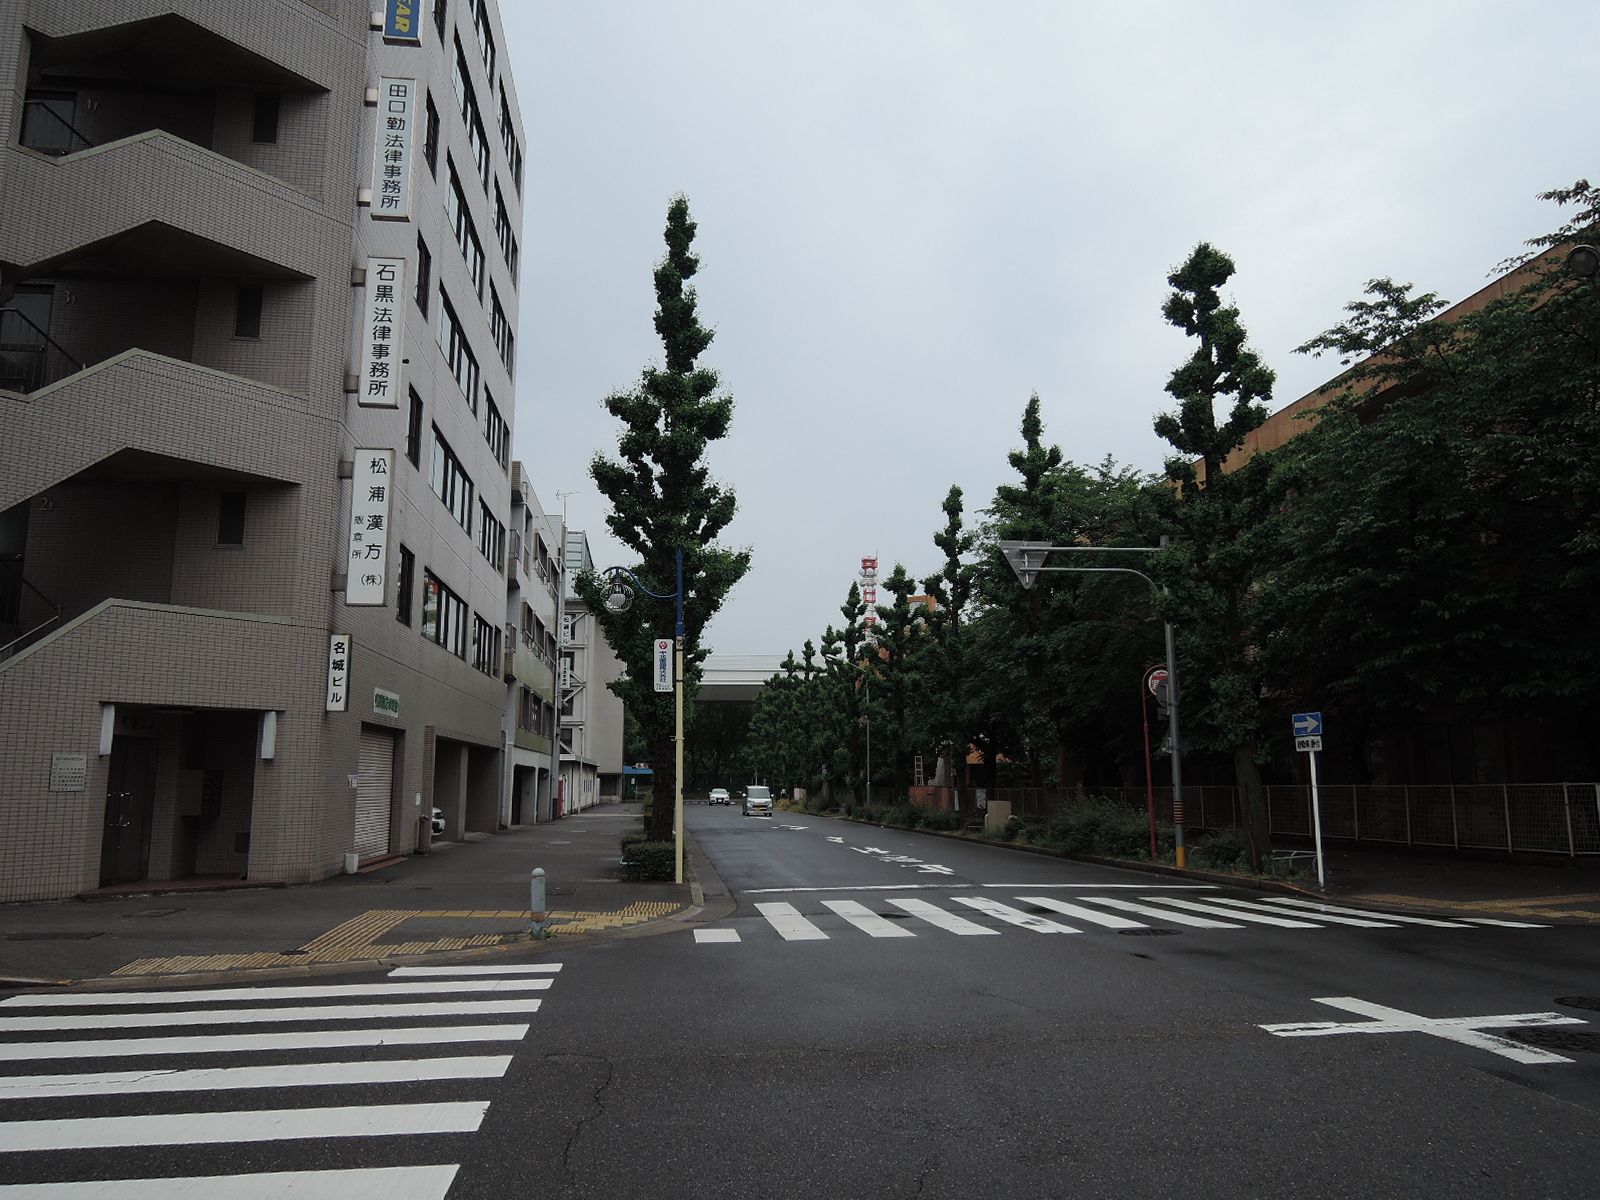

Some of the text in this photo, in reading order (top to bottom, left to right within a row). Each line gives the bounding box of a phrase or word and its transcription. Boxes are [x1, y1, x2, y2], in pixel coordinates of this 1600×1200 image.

[380, 84, 407, 209] 田口勤法律事務所
[368, 264, 396, 396] 石黒法律事務所
[331, 641, 345, 703] 名城ビル
